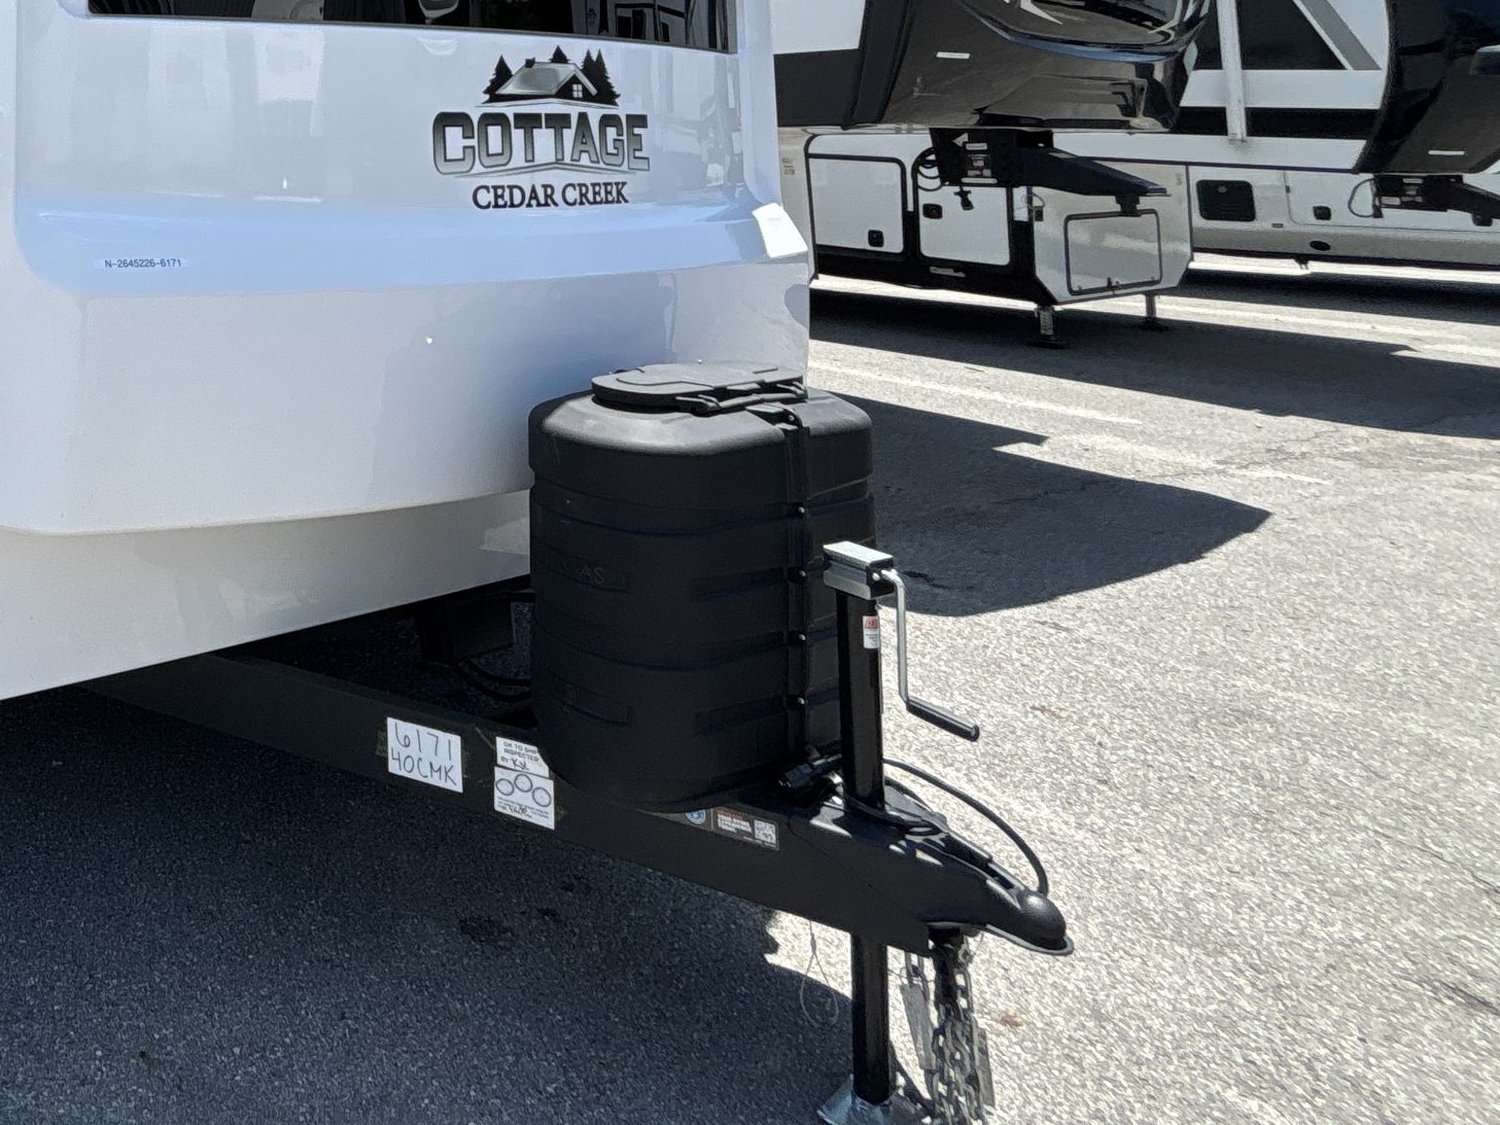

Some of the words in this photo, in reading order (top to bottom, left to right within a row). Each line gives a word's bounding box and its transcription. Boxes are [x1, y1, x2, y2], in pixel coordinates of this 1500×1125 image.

[432, 111, 650, 175] COTTAGE
[472, 184, 559, 210] CEDAR
[561, 181, 629, 206] CREEK
[394, 722, 452, 761] 6171
[504, 748, 540, 762] INSPECTED
[391, 747, 457, 786] 40CMK
